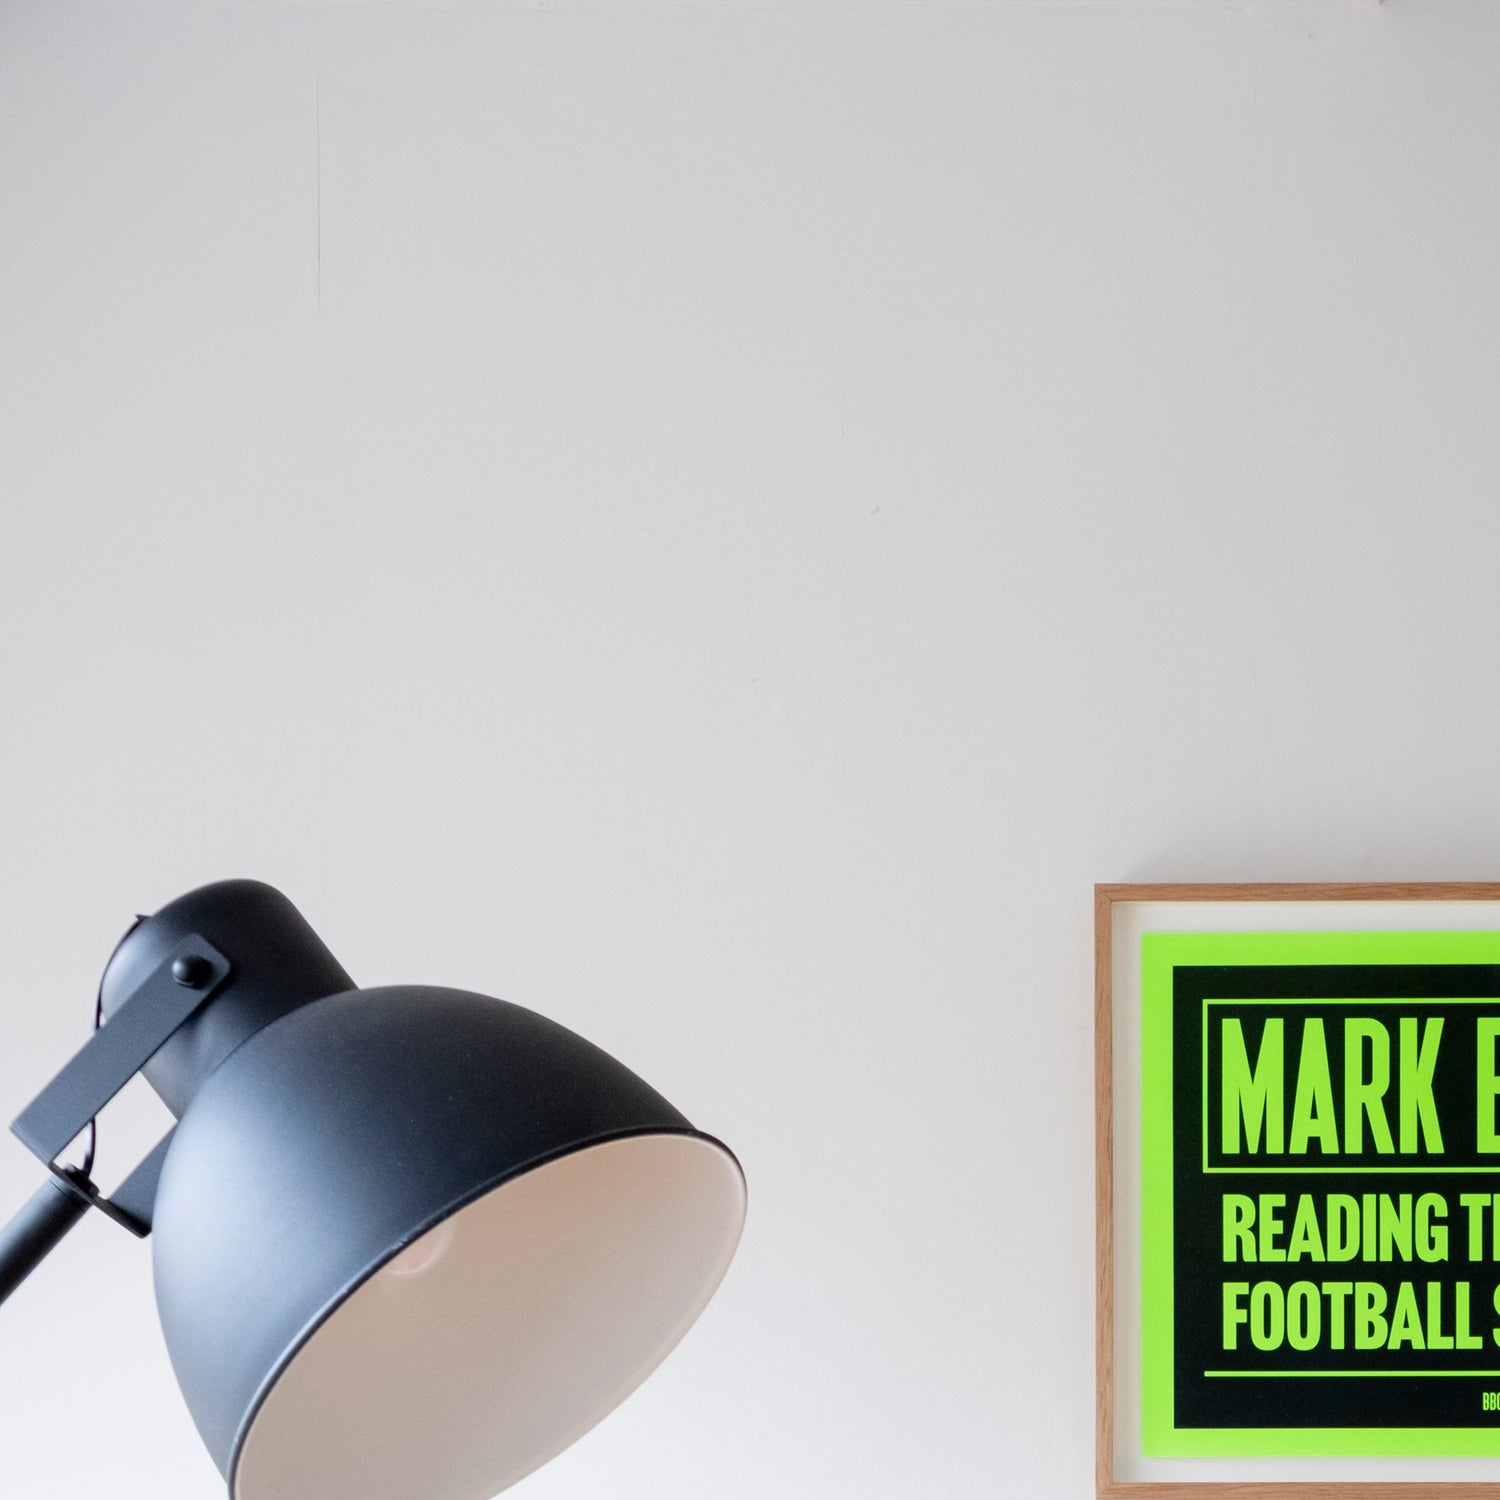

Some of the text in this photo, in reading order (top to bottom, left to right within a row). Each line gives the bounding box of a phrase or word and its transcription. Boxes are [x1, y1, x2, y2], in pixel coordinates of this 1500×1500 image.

[1222, 1018, 1444, 1154] MARK
[1223, 1193, 1448, 1262] READING
[1223, 1281, 1483, 1351] FOOTBALL
